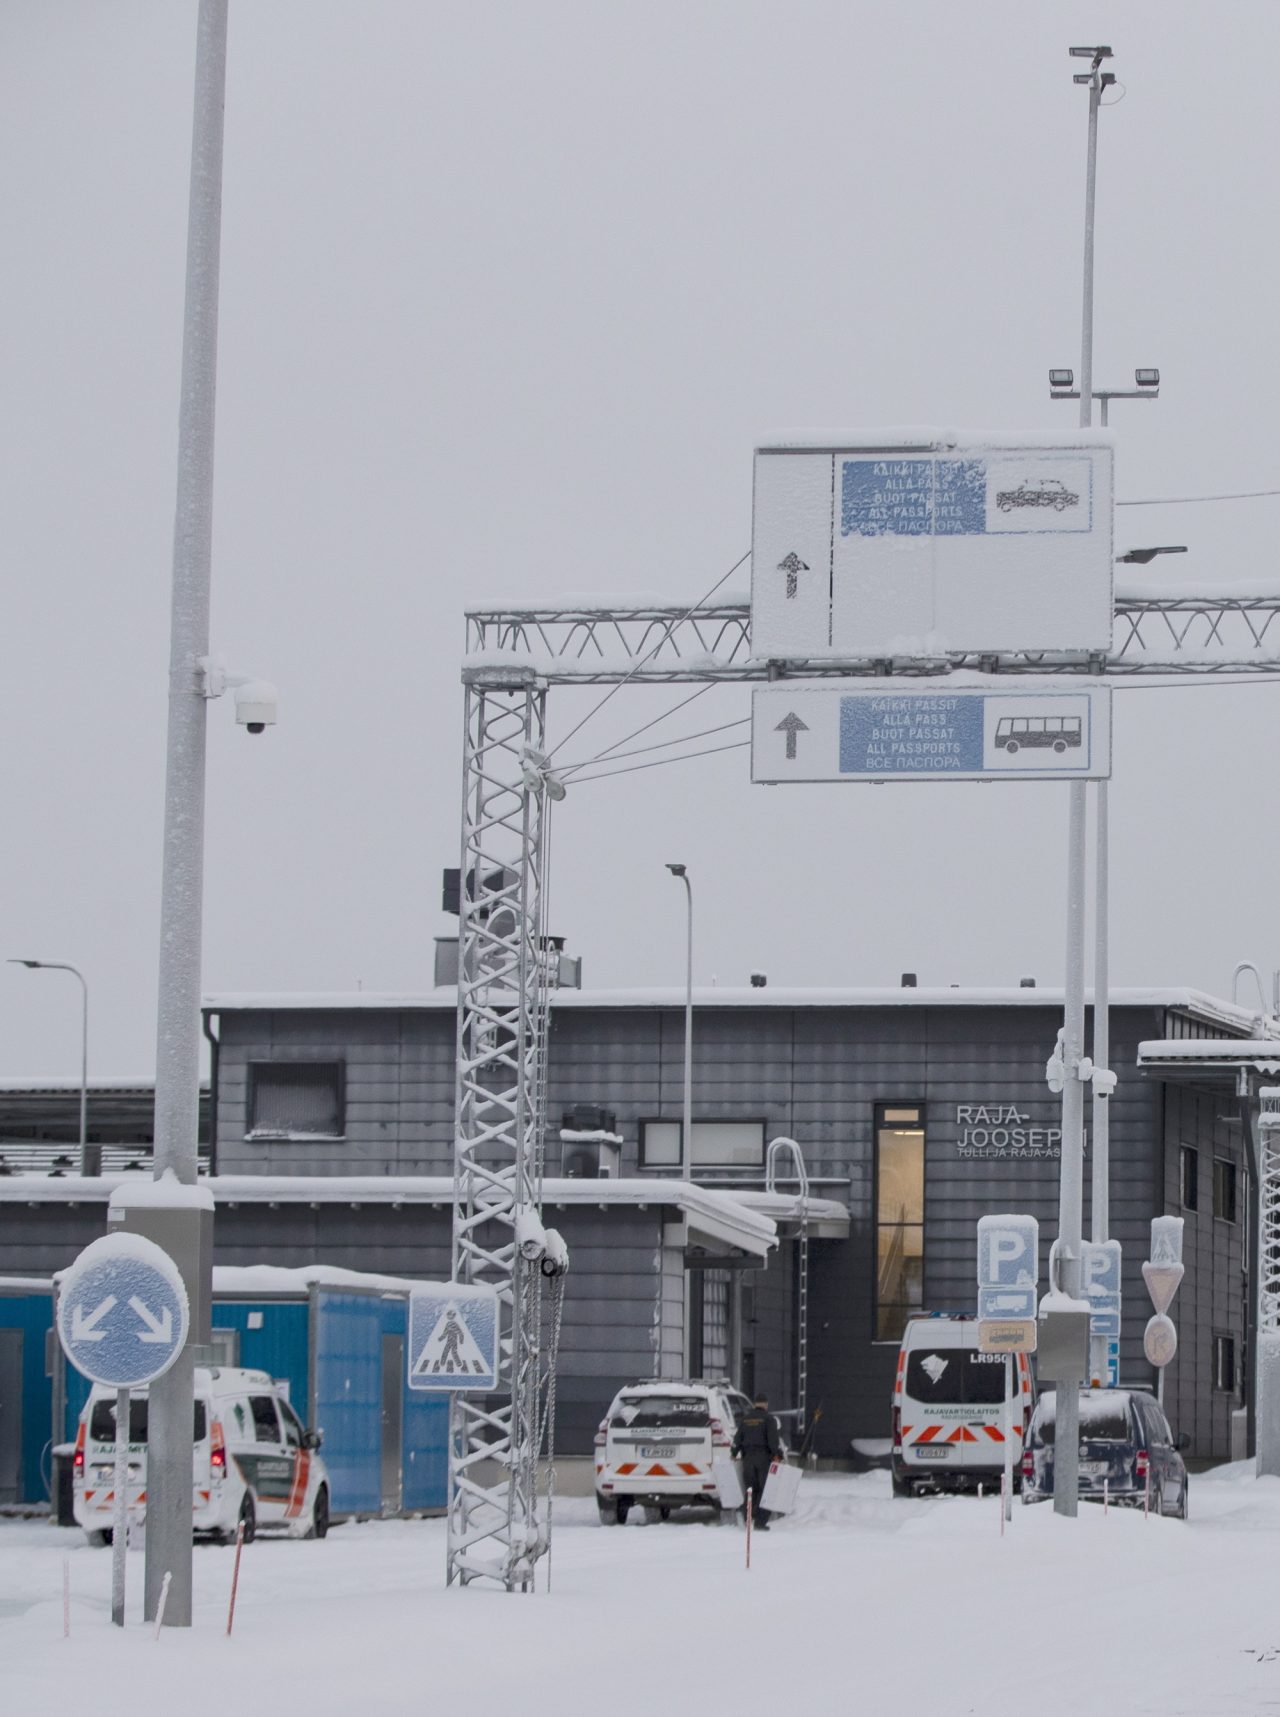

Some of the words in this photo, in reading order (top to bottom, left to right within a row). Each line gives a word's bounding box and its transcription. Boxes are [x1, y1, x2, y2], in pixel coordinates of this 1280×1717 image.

[885, 478, 913, 490] ALLA
[874, 492, 905, 504] BUOT
[872, 699, 911, 711] KAIKKI
[915, 699, 958, 711] PASSIT
[883, 713, 911, 725] ALLA
[915, 713, 947, 725] PASS
[872, 728, 904, 740] BUOT
[909, 728, 955, 740] PASSAT
[867, 743, 887, 754] ALL
[891, 742, 961, 754] PASSPORTS
[957, 1105, 1030, 1124] RAJA-
[957, 1128, 1087, 1147] JOOSEPI
[957, 1147, 989, 1158] TULLI
[993, 1147, 1006, 1158] JA
[924, 1408, 1000, 1416] RAJAVARTIOLAITOS
